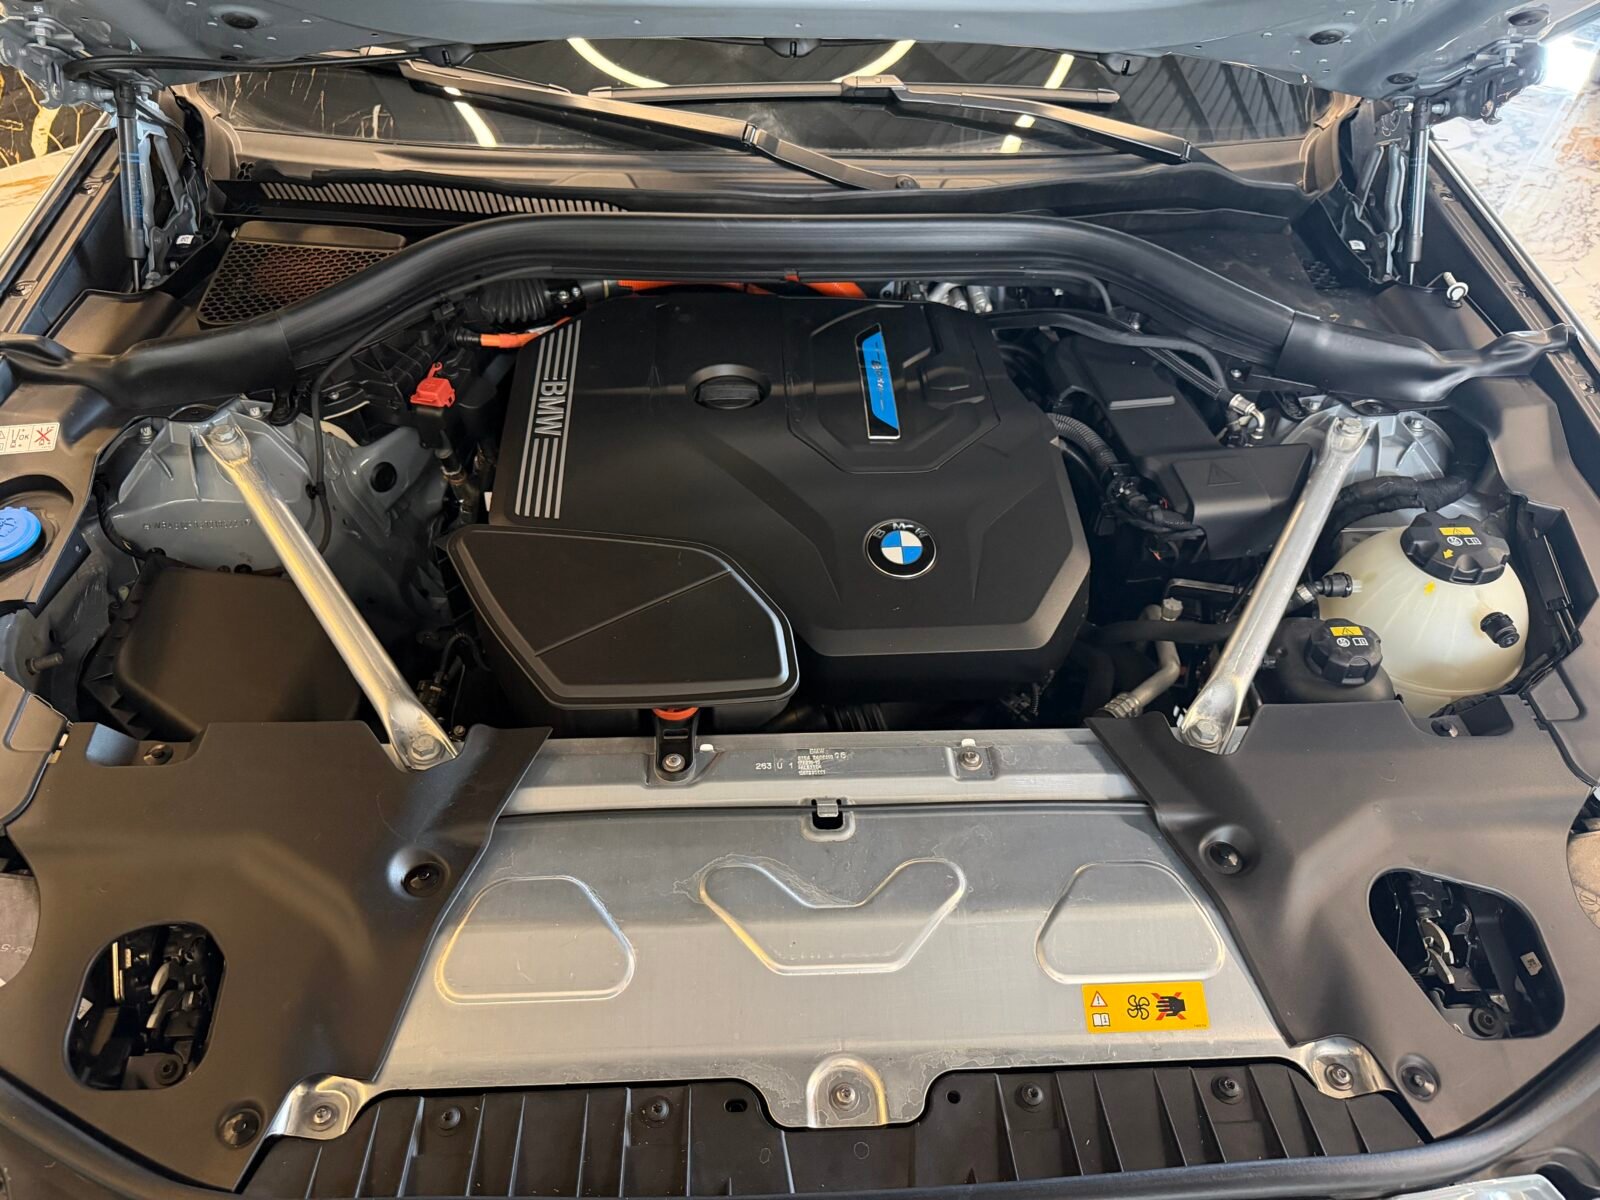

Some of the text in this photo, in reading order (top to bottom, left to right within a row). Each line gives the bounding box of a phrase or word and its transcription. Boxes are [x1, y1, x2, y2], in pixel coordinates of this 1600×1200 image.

[534, 381, 568, 437] BMW
[873, 522, 928, 539] BMW
[755, 762, 772, 770] 263
